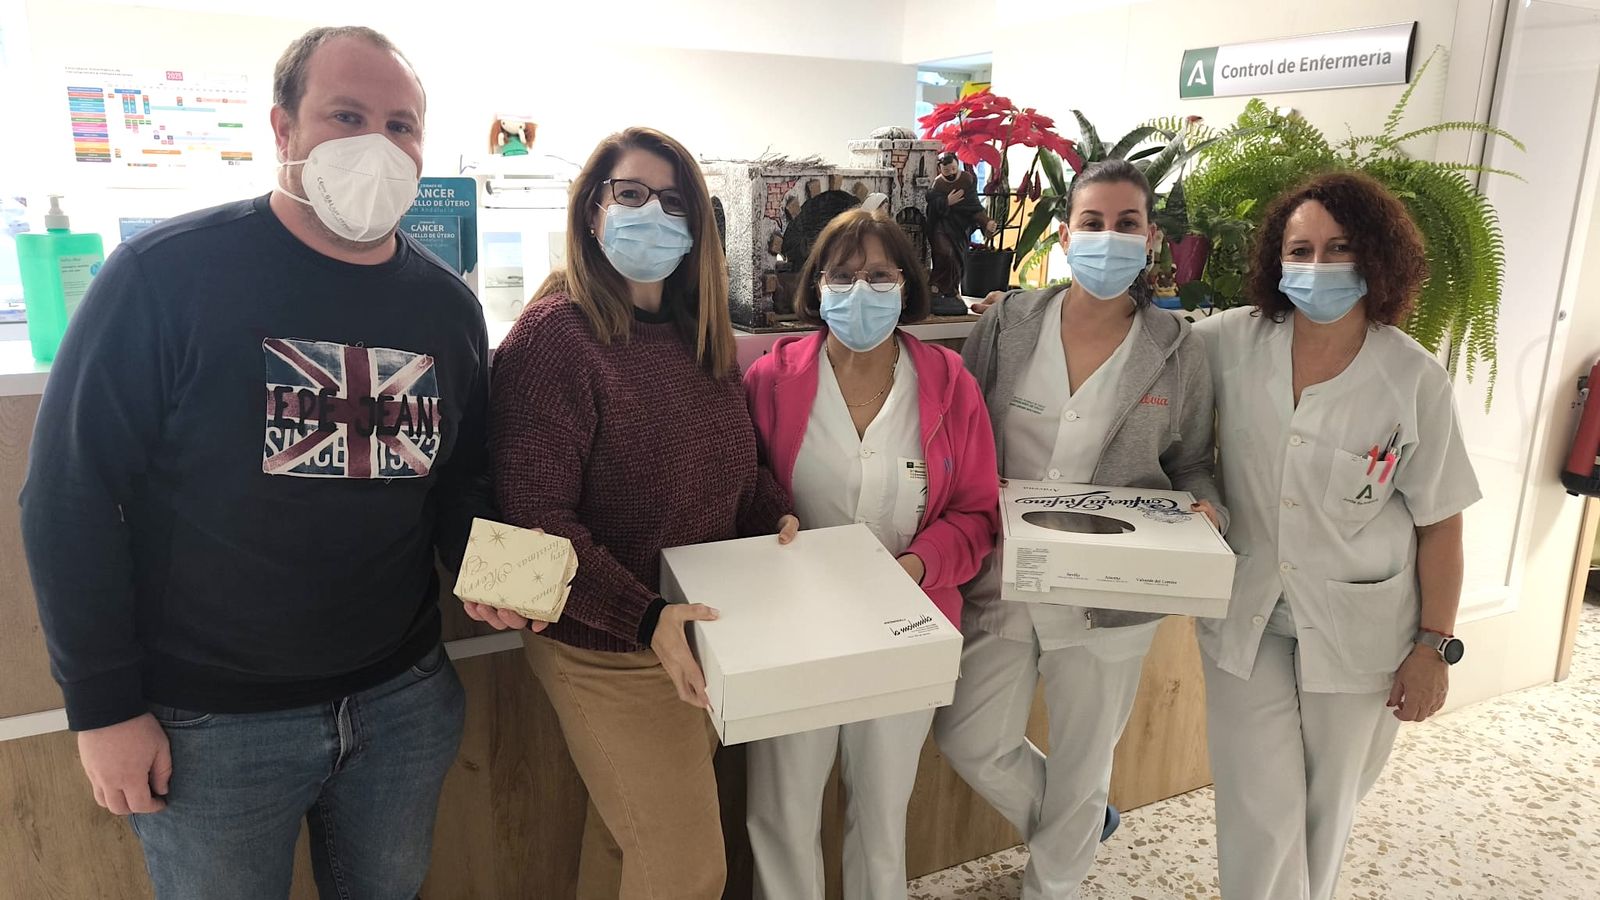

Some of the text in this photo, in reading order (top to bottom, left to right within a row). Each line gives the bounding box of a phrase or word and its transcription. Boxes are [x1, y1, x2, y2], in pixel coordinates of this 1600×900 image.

[1221, 58, 1274, 80] Control
[1277, 57, 1296, 74] de
[444, 198, 470, 207] ÚTERO
[273, 385, 340, 436] EPE
